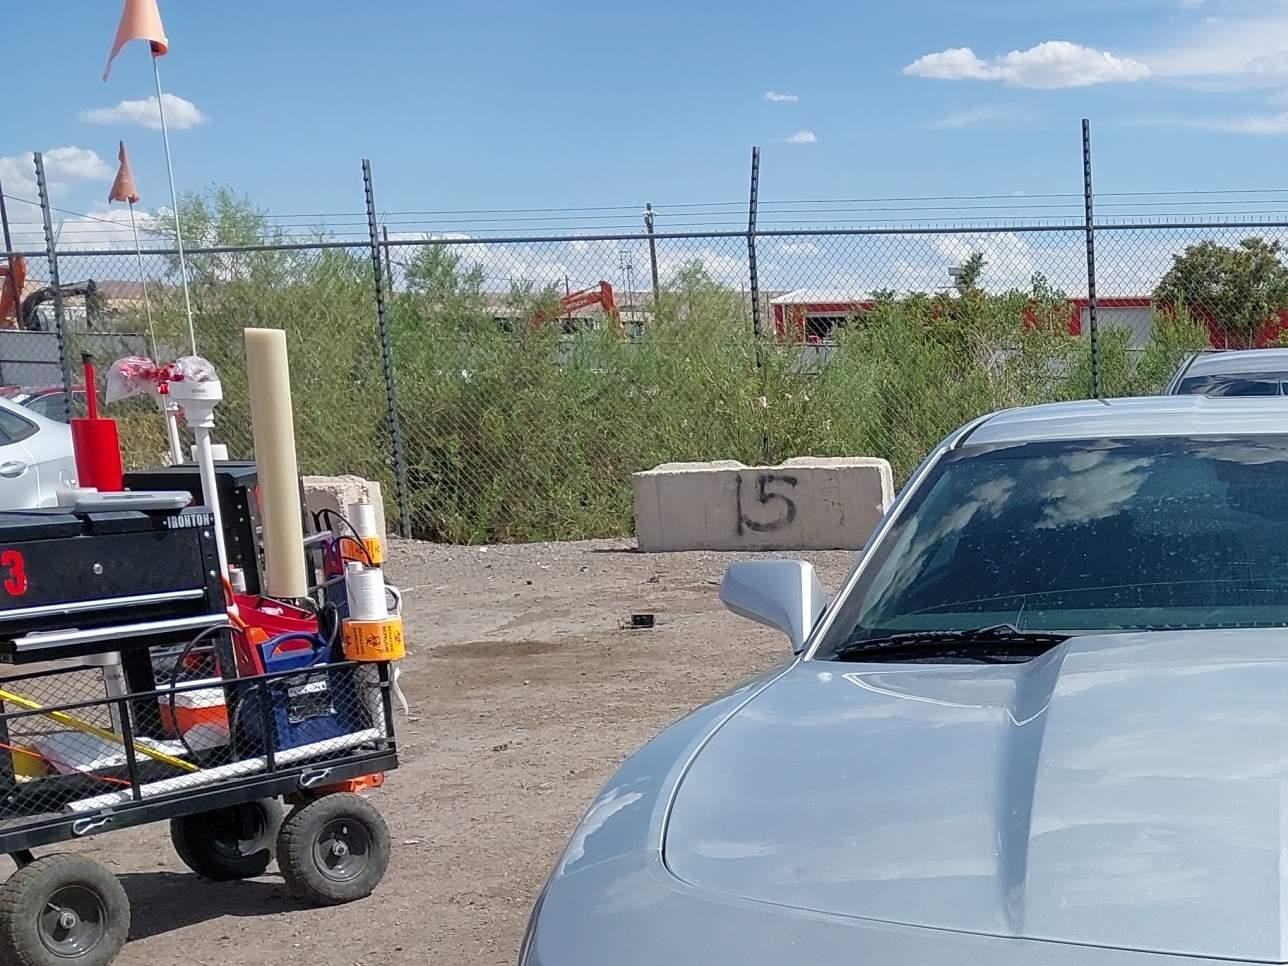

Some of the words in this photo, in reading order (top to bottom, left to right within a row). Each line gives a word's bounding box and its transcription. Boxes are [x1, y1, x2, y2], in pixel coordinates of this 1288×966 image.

[167, 513, 210, 529] IRONTON
[735, 474, 798, 536] 15
[1, 550, 27, 595] 3
